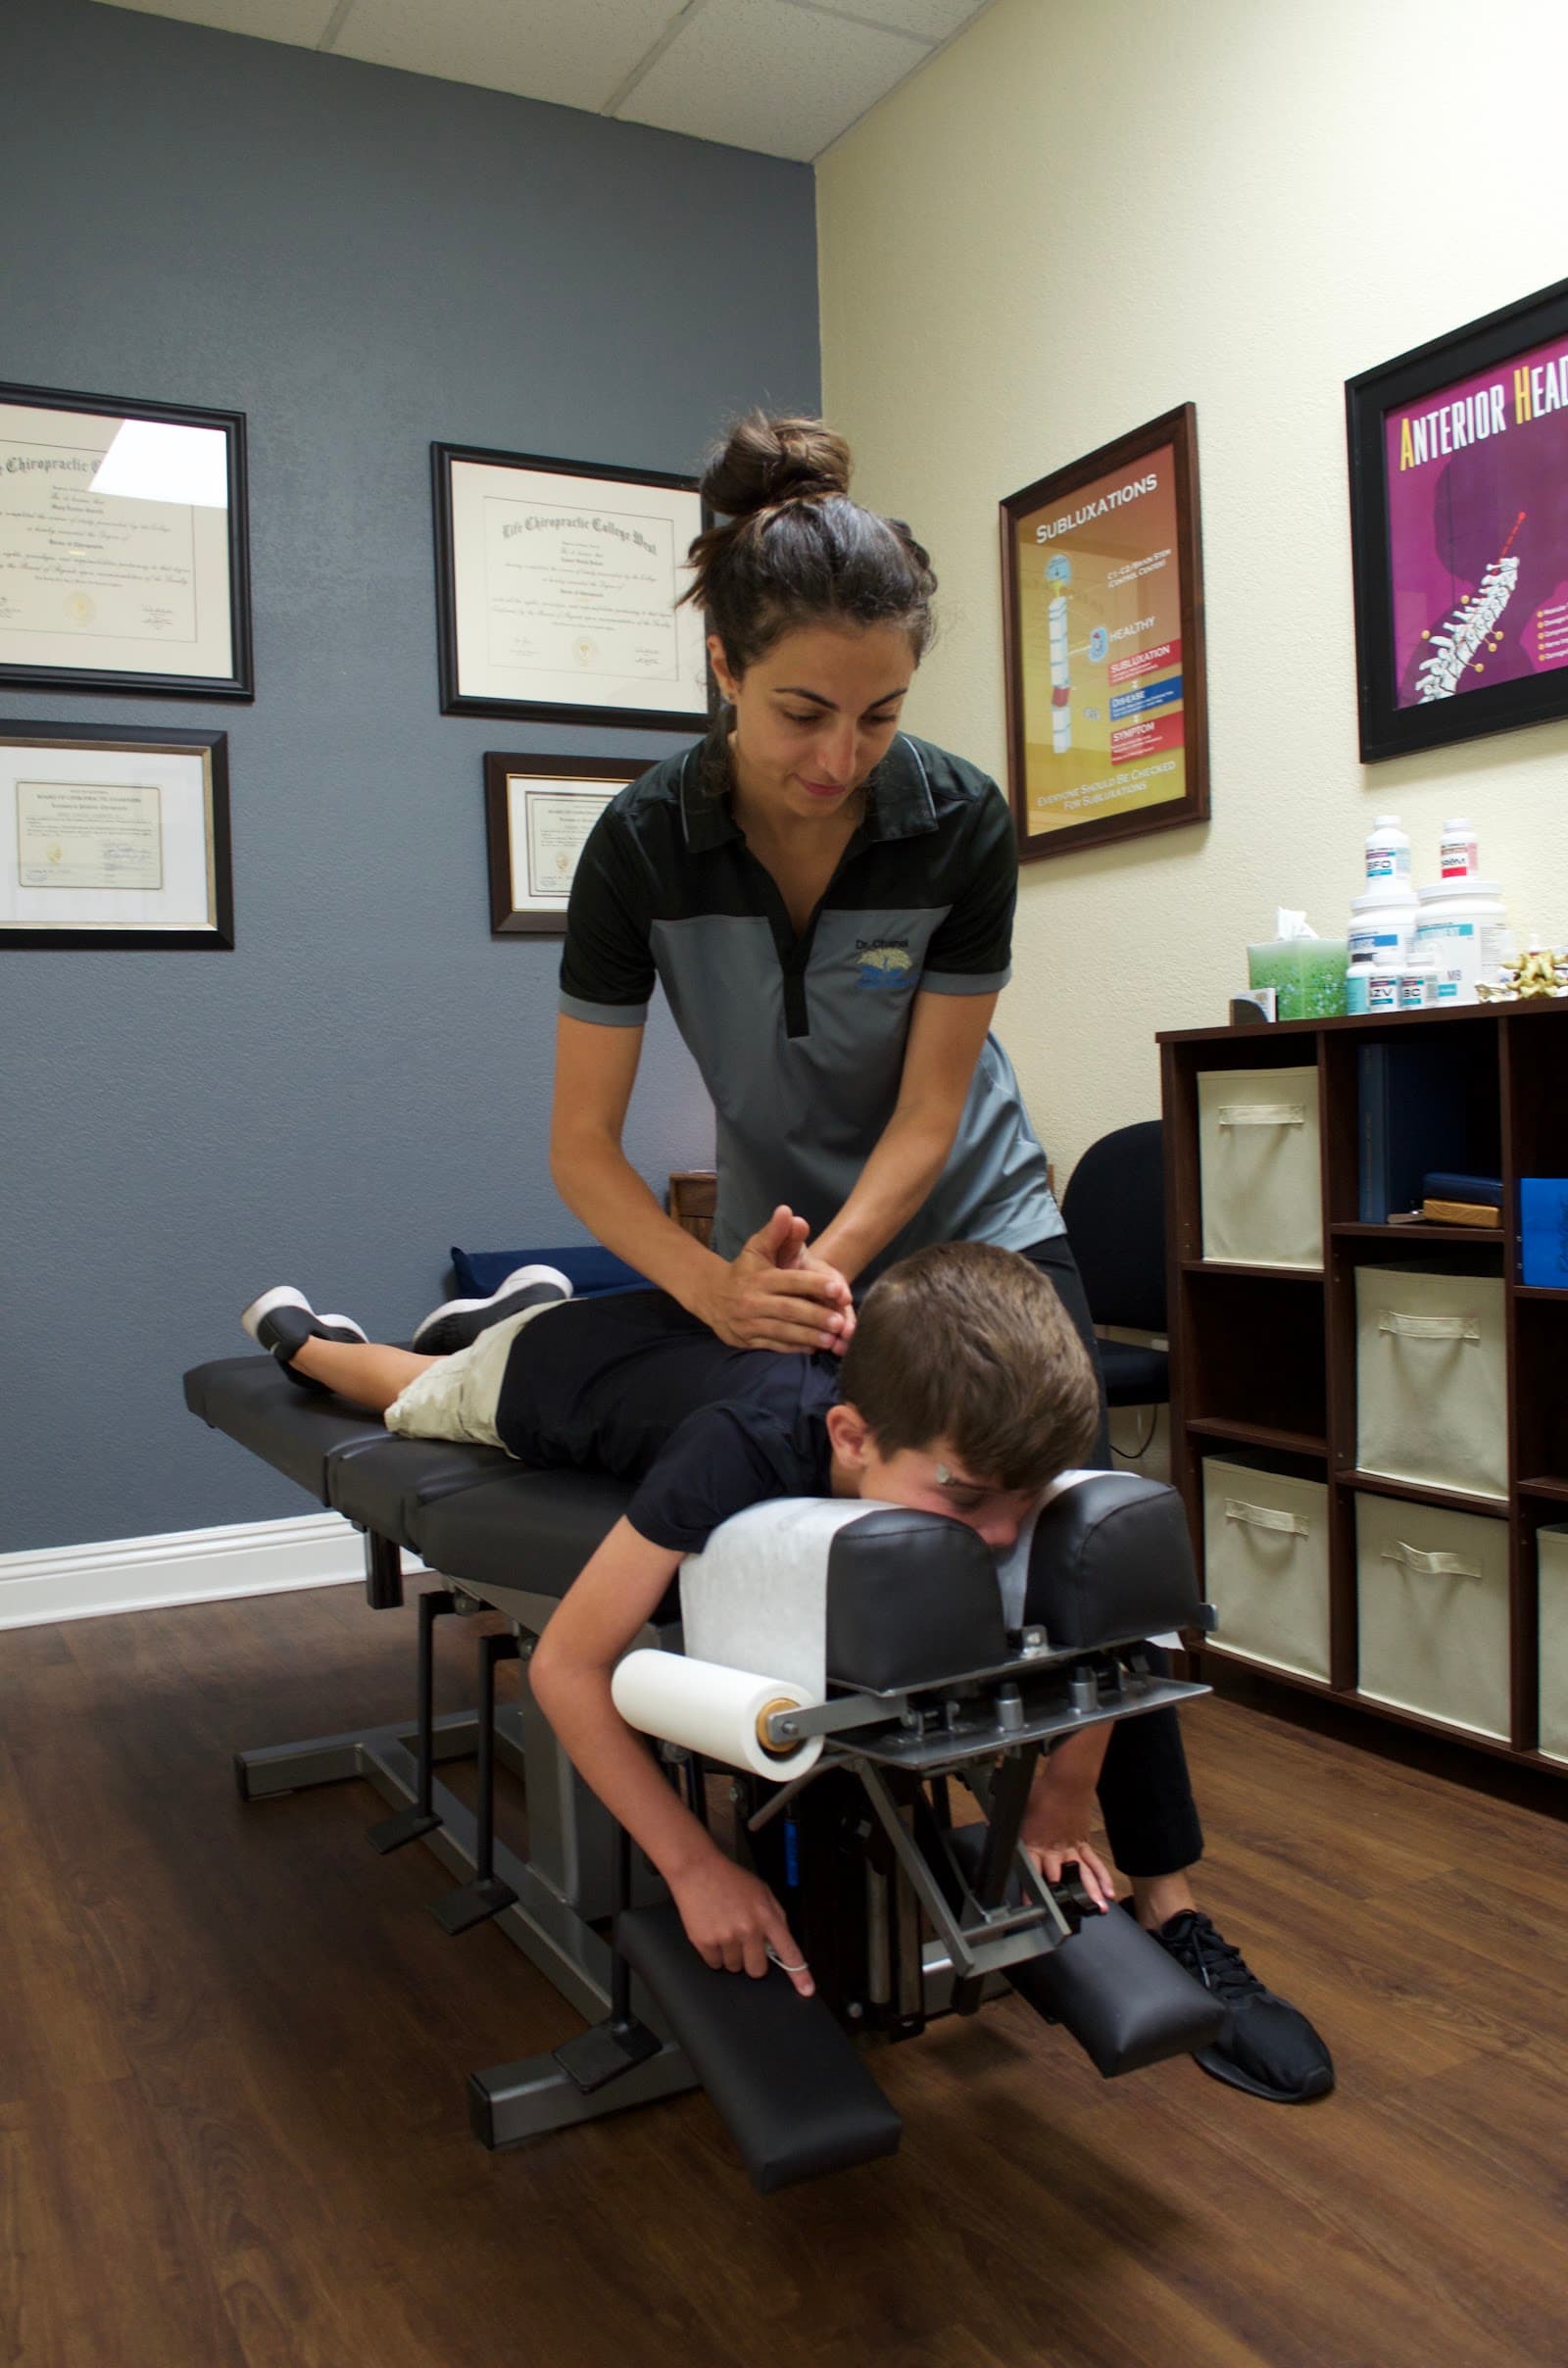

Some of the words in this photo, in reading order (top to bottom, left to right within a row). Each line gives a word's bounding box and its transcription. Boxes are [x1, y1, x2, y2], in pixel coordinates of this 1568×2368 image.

[1399, 384, 1507, 471] ANTERIOR
[1035, 473, 1157, 544] SUBLUXATIONS
[1109, 616, 1155, 642] HEALTHY
[1110, 644, 1170, 673] SUBLUXATION
[1112, 690, 1146, 708] DISEASE
[1112, 721, 1155, 742] SYMPTOM
